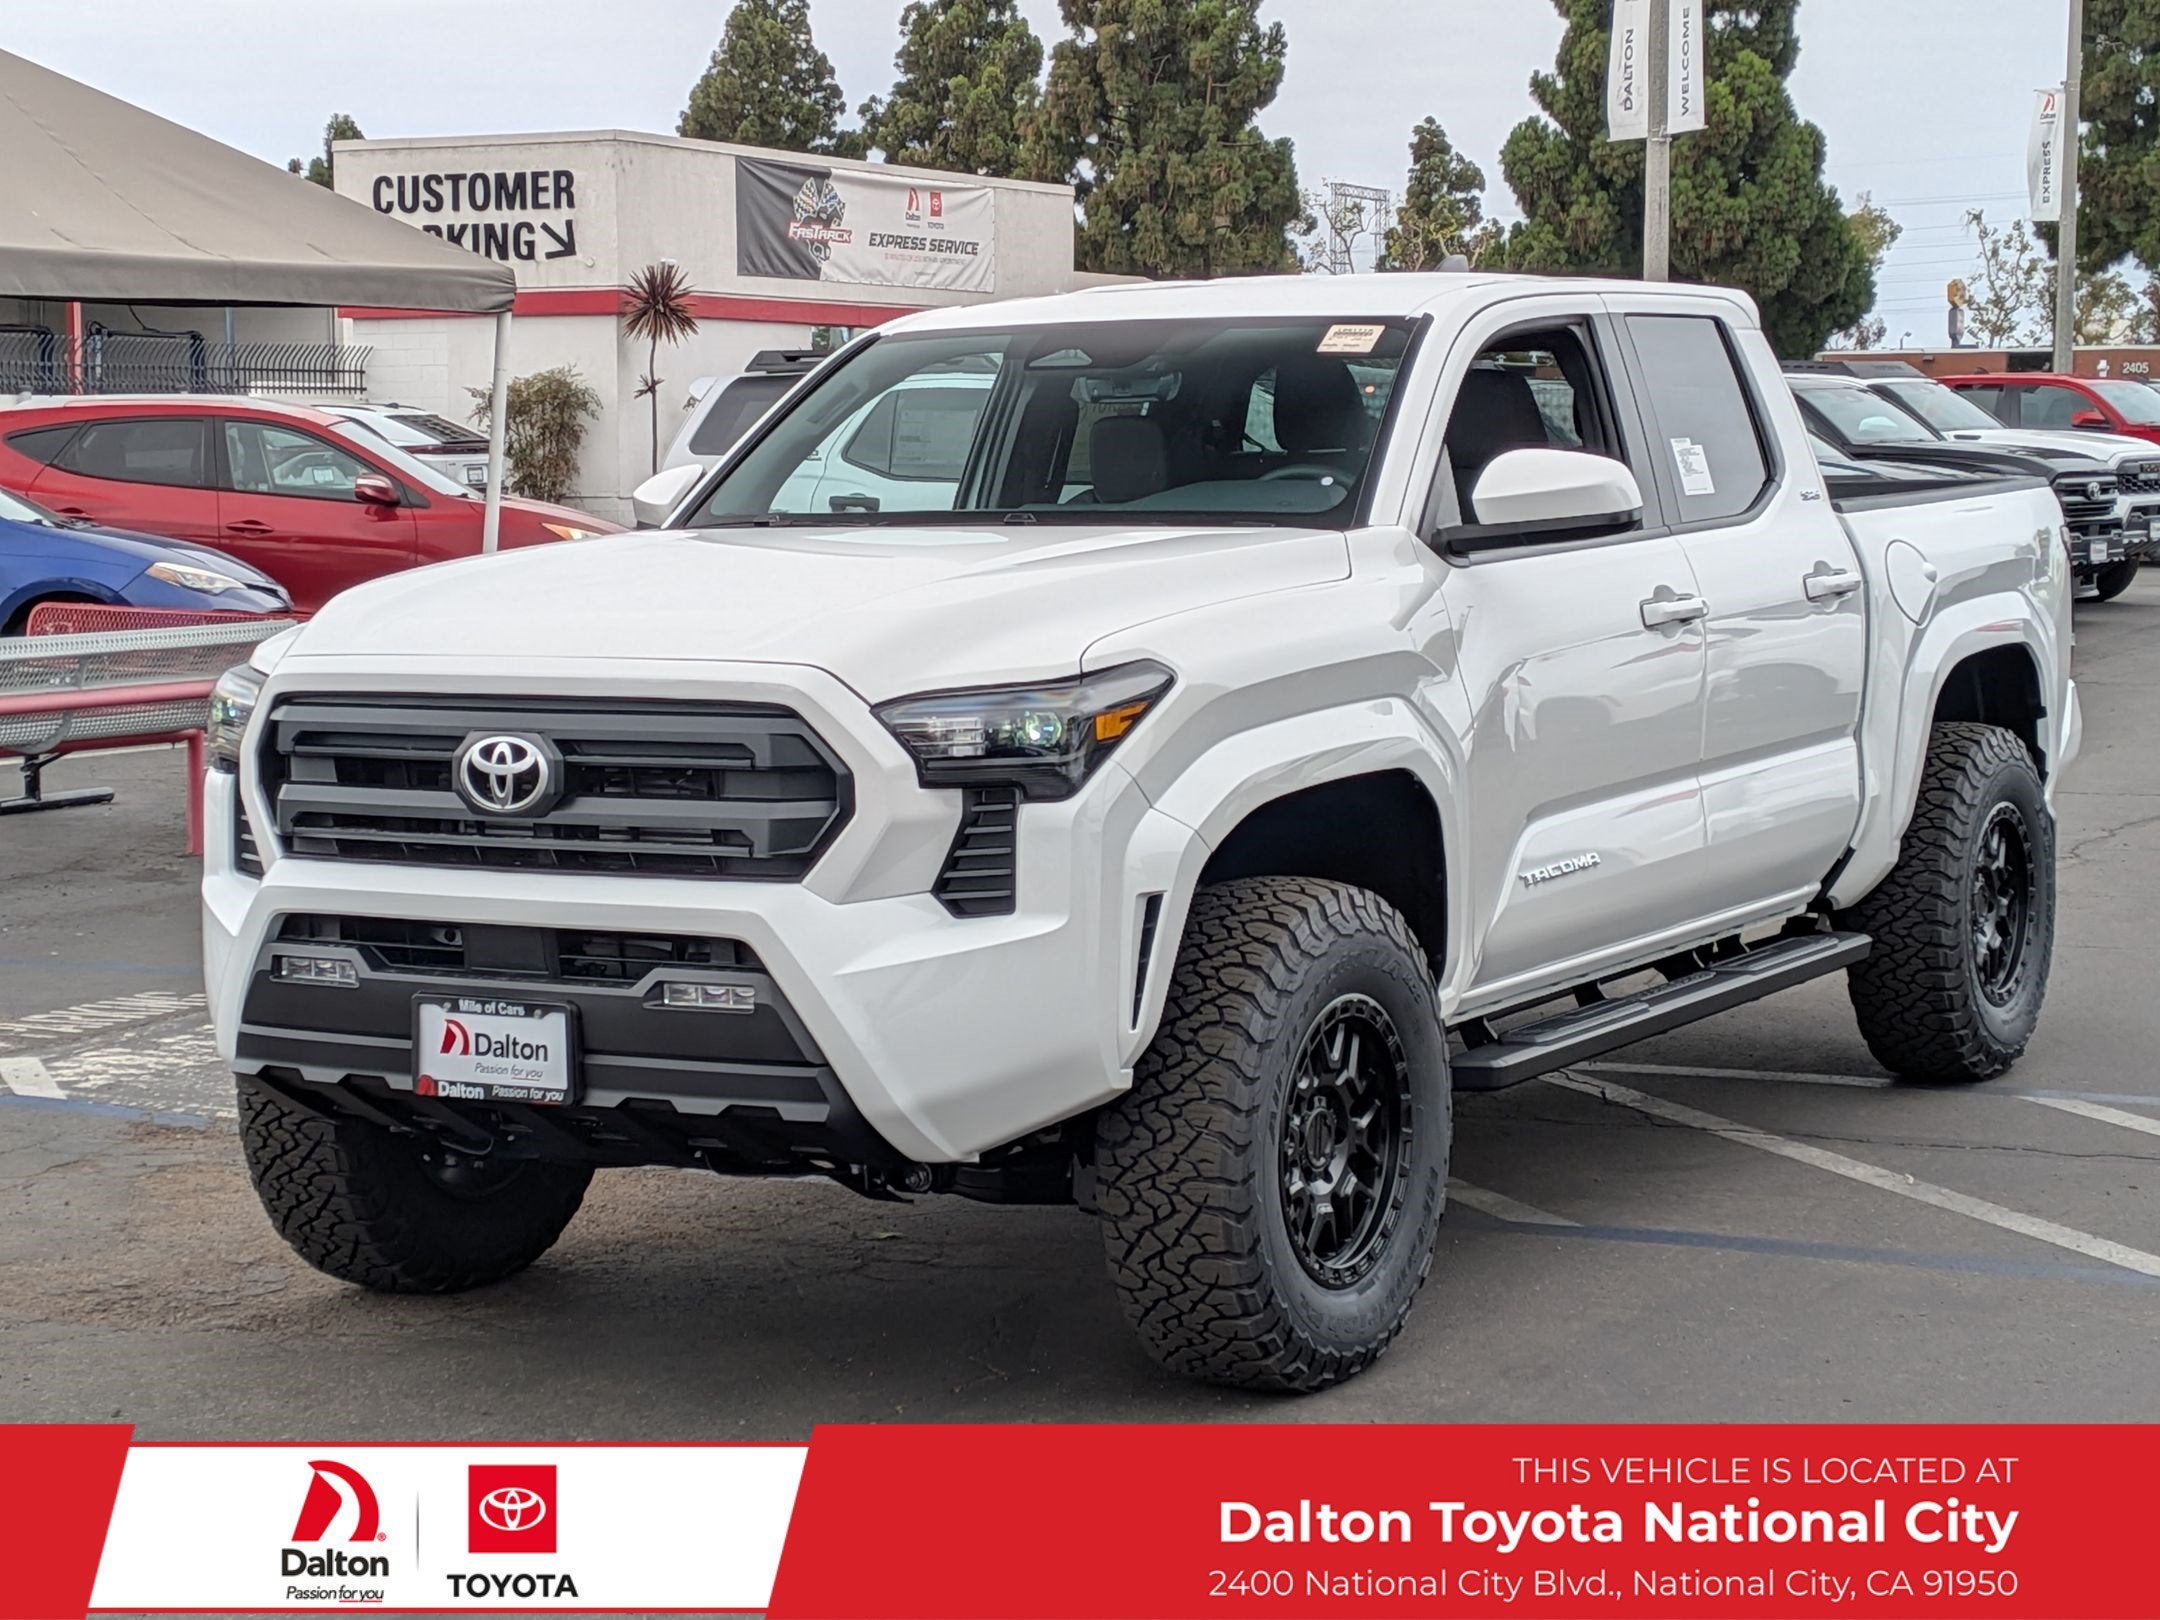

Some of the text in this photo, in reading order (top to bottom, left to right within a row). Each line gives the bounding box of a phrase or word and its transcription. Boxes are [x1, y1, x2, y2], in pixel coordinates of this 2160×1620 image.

[1624, 28, 1634, 112] DALTON
[1681, 7, 1690, 116] WELCOME
[2042, 140, 2051, 204] EXPRESS
[372, 169, 576, 214] CUSTOMER
[869, 232, 980, 256] EXPRESS SERVICE
[2122, 361, 2150, 374] 2405
[1519, 852, 1601, 888] TACOMA
[458, 999, 526, 1016] Mile of Cars
[474, 1032, 549, 1062] Dalton
[474, 1062, 544, 1079] Passion for you
[438, 1080, 485, 1100] Dalton
[491, 1085, 565, 1102] Passion for you
